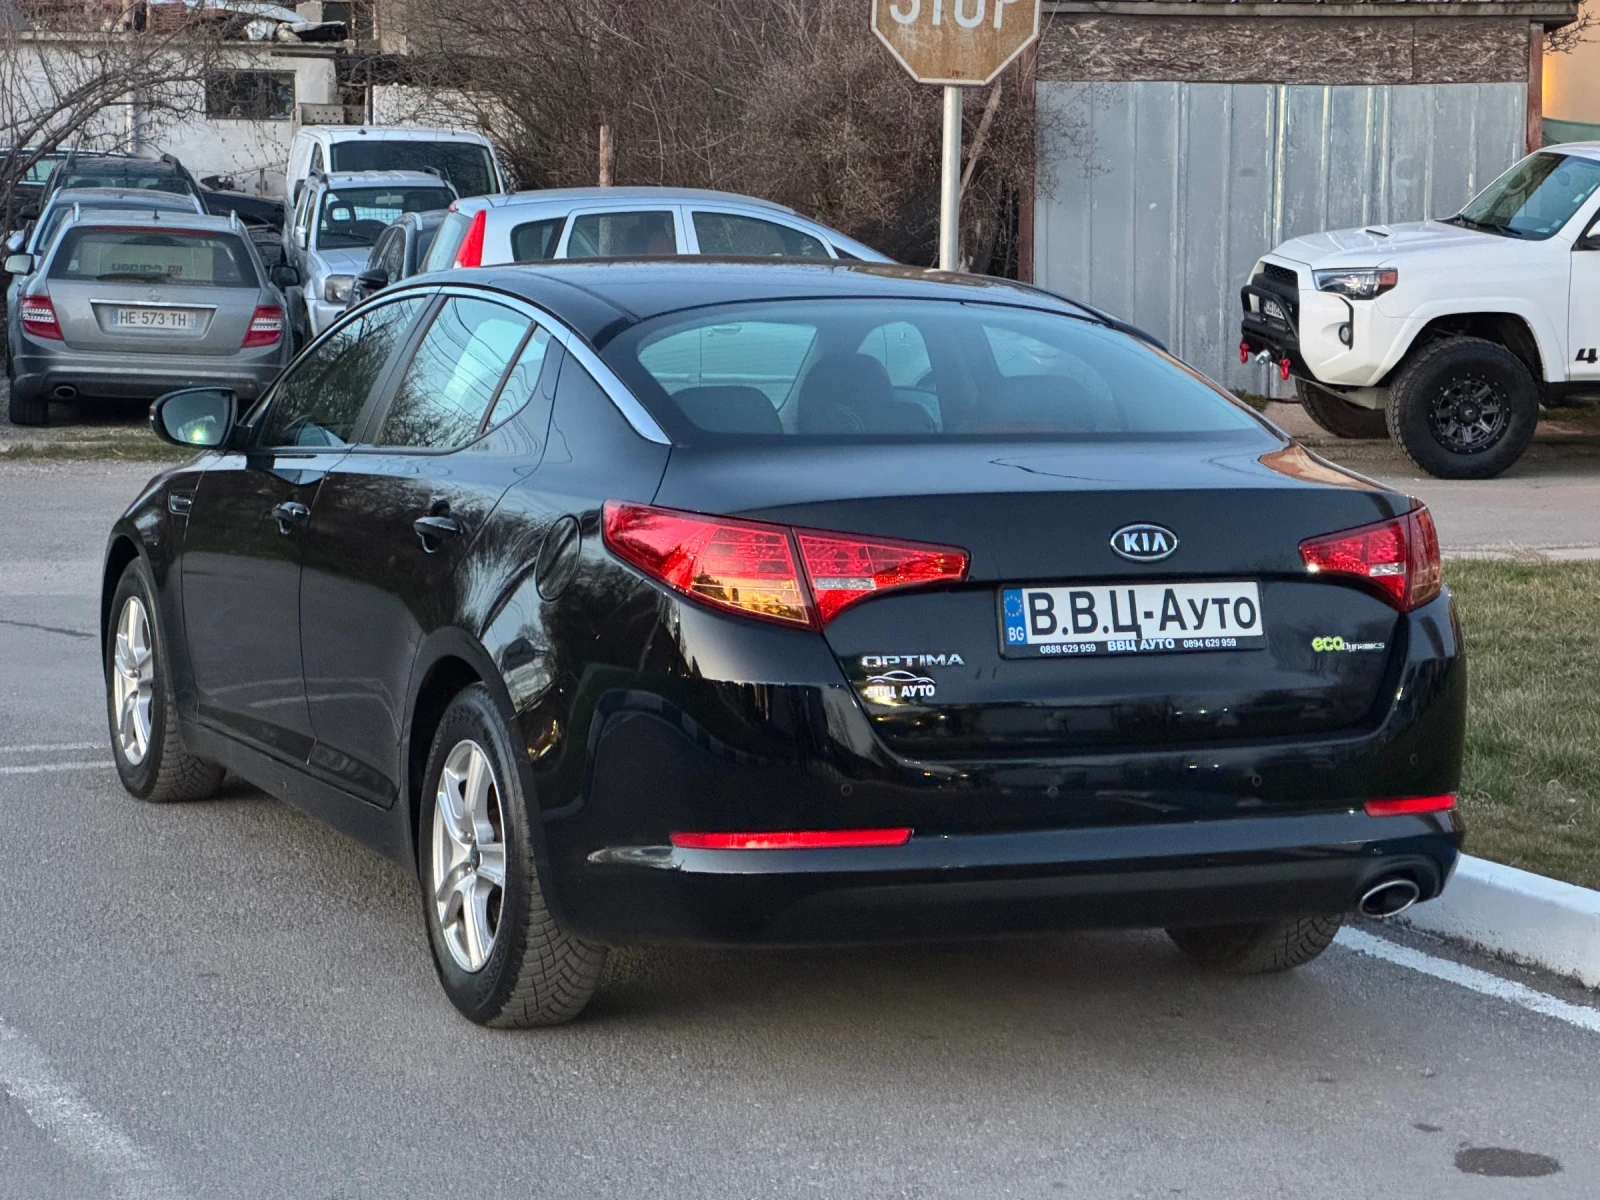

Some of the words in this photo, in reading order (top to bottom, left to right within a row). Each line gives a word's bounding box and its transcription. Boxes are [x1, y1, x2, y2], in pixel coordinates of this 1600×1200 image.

[1123, 532, 1169, 552] KIA
[1008, 627, 1025, 642] BG
[1040, 645, 1061, 654] 0888
[1062, 644, 1078, 653] 629
[1080, 643, 1096, 653] 959
[1183, 639, 1203, 648] 0894
[1205, 638, 1220, 647] 629
[1221, 637, 1237, 647] 959
[861, 653, 965, 668] OPTIMA
